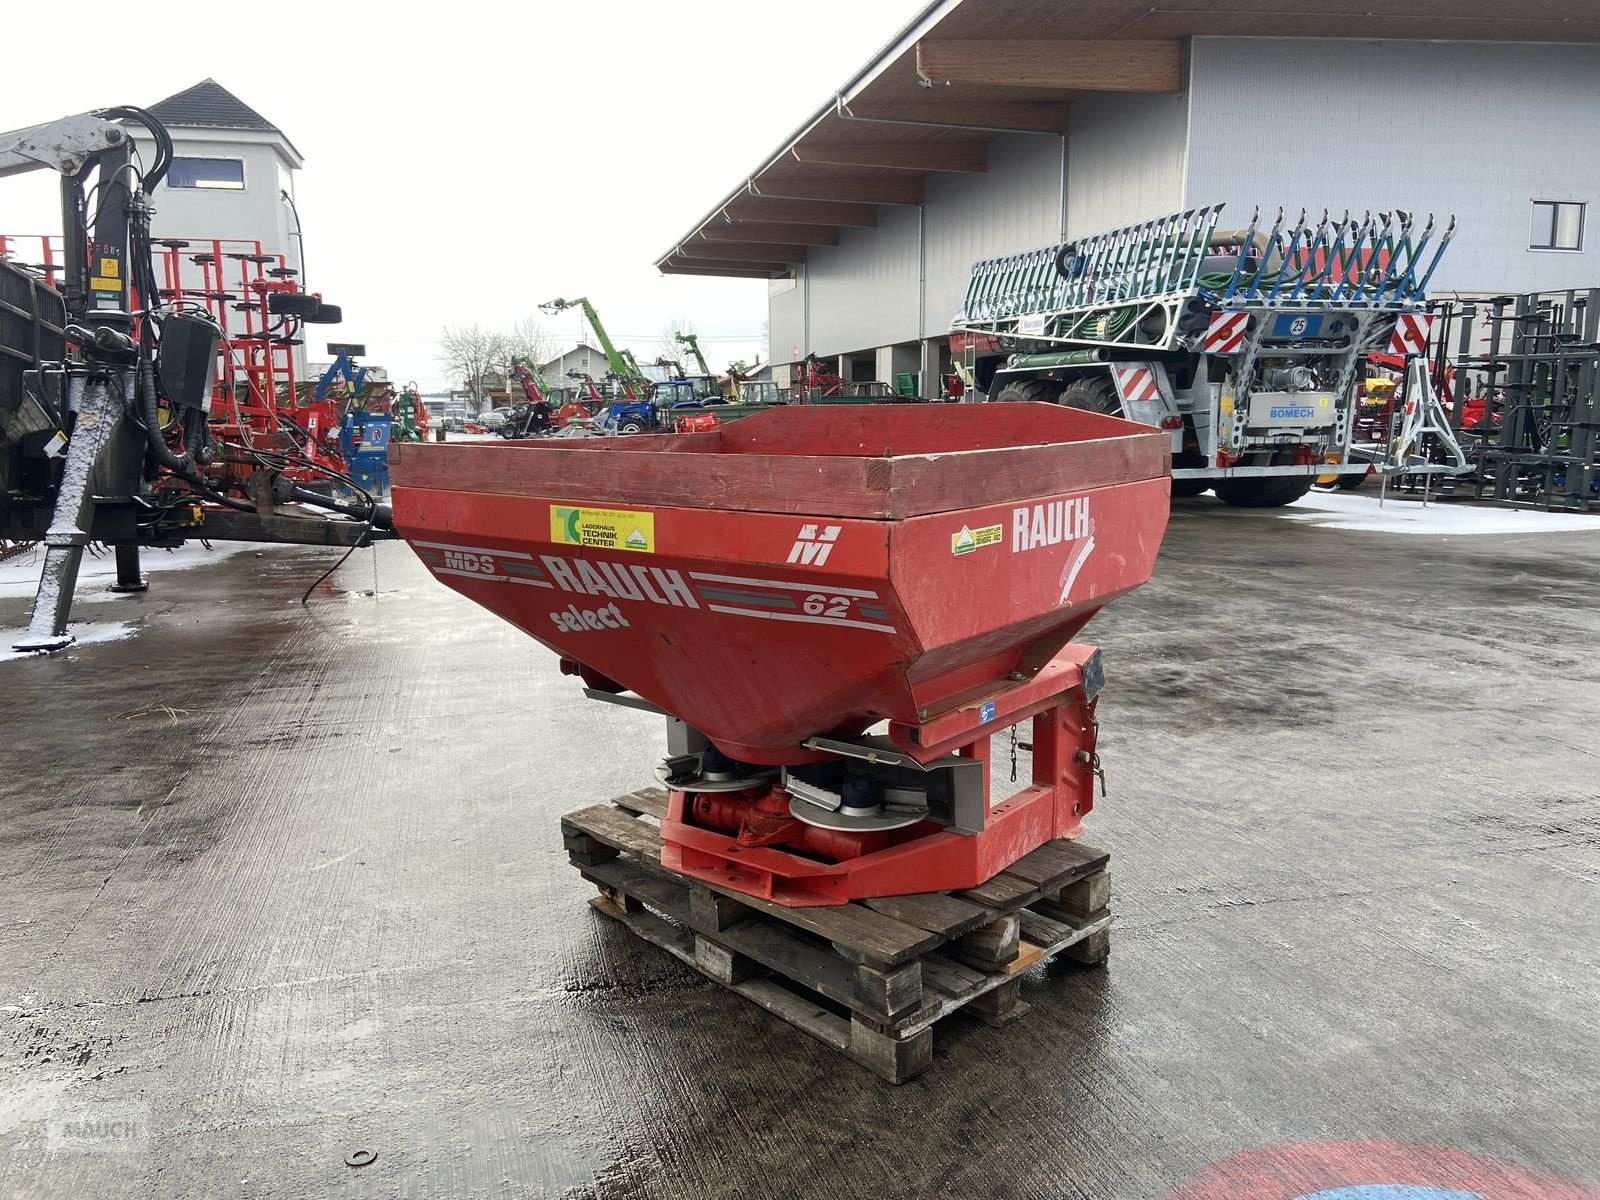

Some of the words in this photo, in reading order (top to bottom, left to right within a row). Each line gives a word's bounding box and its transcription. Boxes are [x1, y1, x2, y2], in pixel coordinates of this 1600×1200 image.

[1293, 320, 1305, 332] 25
[1270, 409, 1314, 418] BOMECH
[581, 523, 615, 532] LAGERHAUS
[1012, 496, 1090, 553] RAUCH
[582, 529, 618, 540] TECHNIK
[582, 538, 615, 547] CENTER
[444, 551, 495, 574] MDS
[539, 555, 700, 609] RAUCH
[802, 594, 850, 618] 62
[550, 601, 631, 633] select
